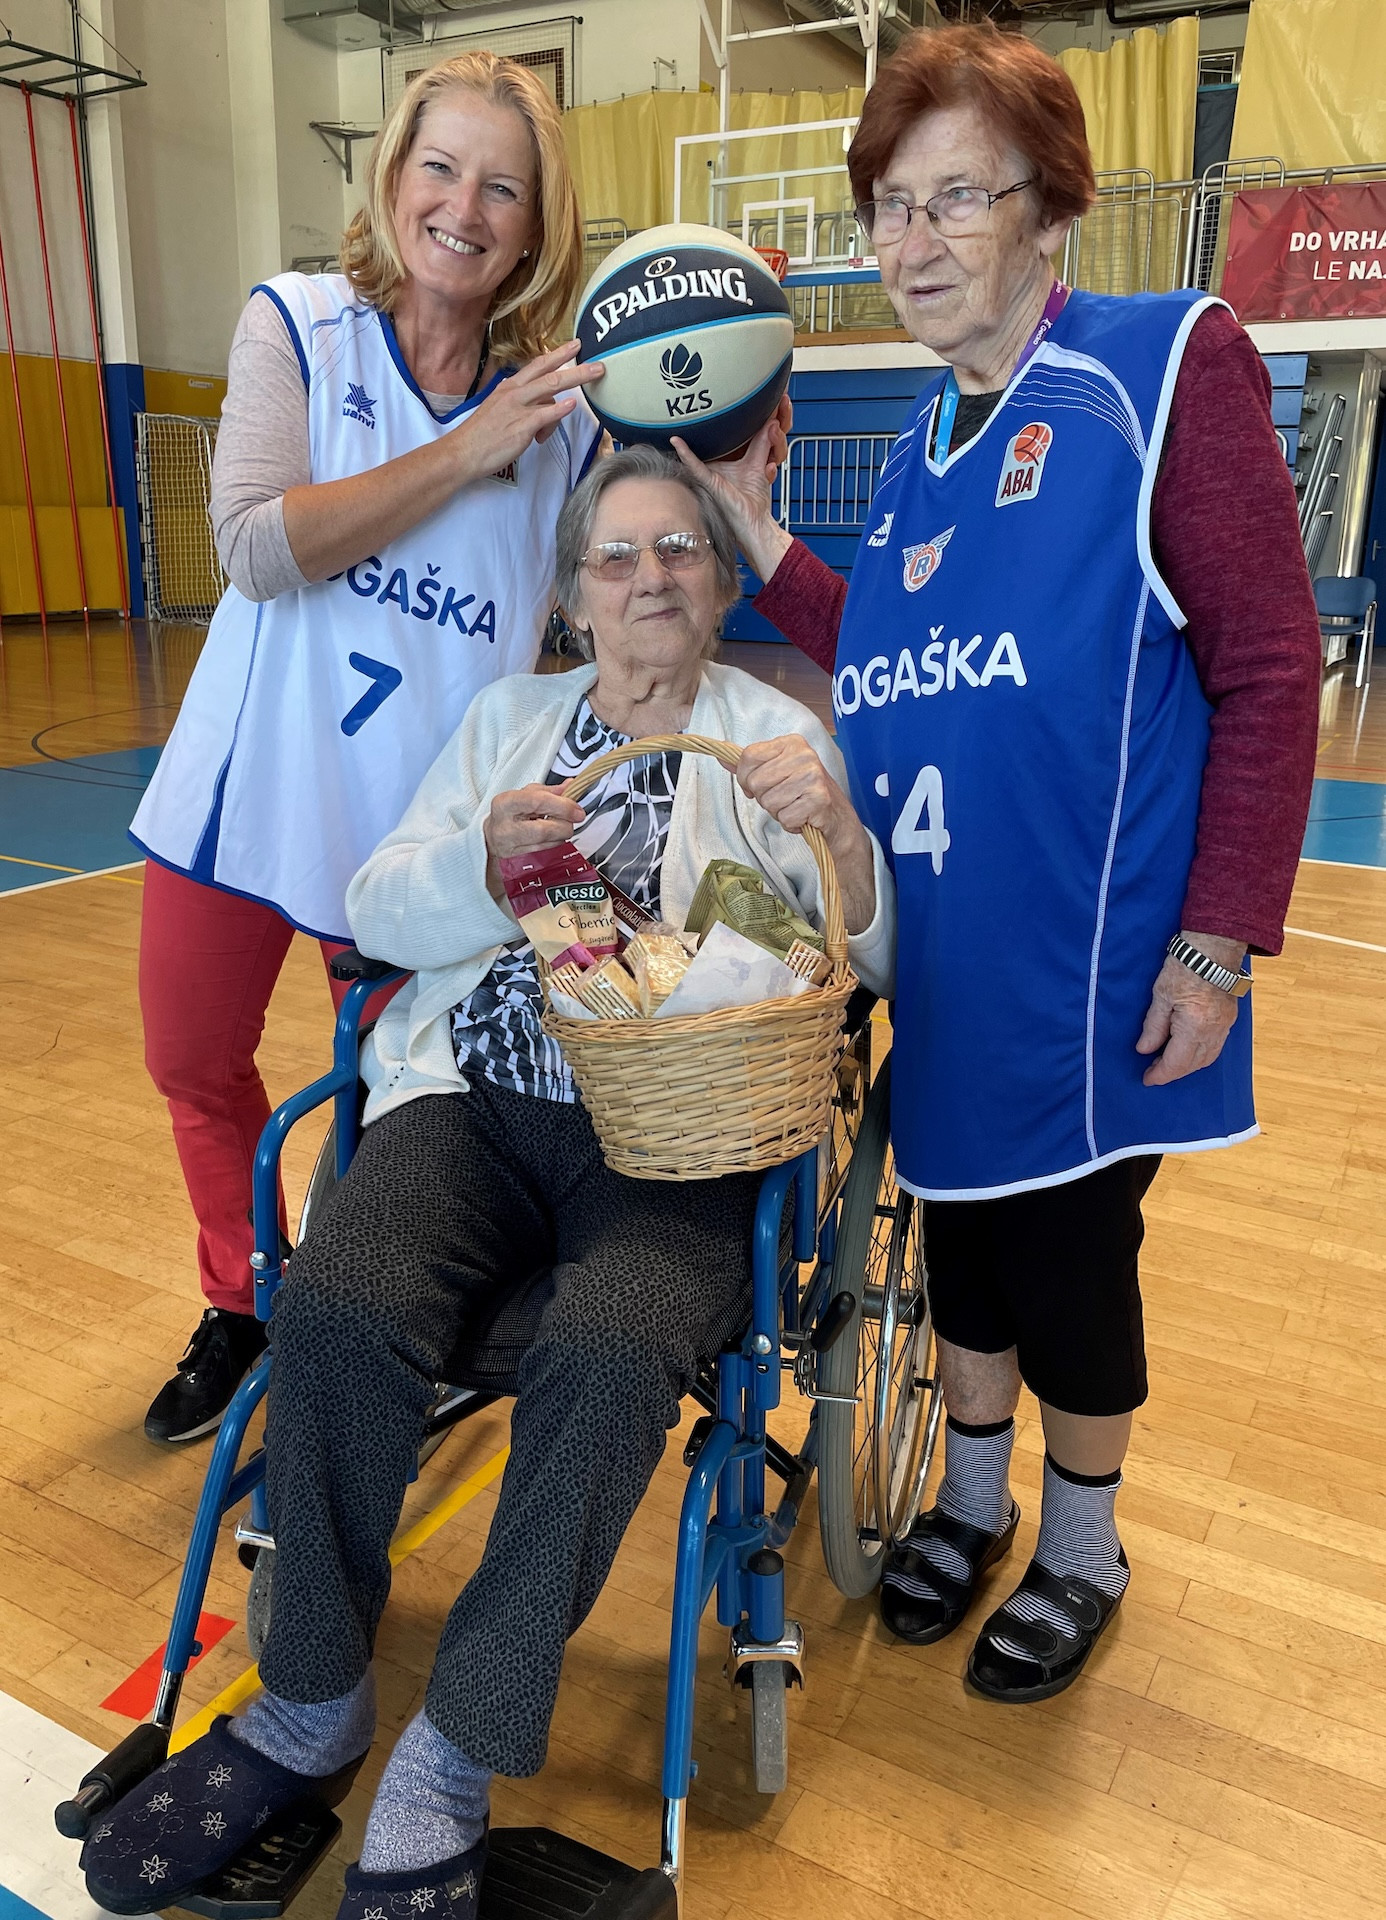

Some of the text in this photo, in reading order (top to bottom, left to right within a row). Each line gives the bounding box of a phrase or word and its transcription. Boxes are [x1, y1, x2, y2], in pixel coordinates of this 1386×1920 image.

[1289, 232, 1322, 252] DO
[1313, 260, 1386, 280] LE NA
[666, 389, 713, 417] KZS
[1000, 467, 1034, 499] ABA
[911, 554, 932, 579] R
[340, 651, 402, 737] 7
[555, 885, 605, 902] Alesto
